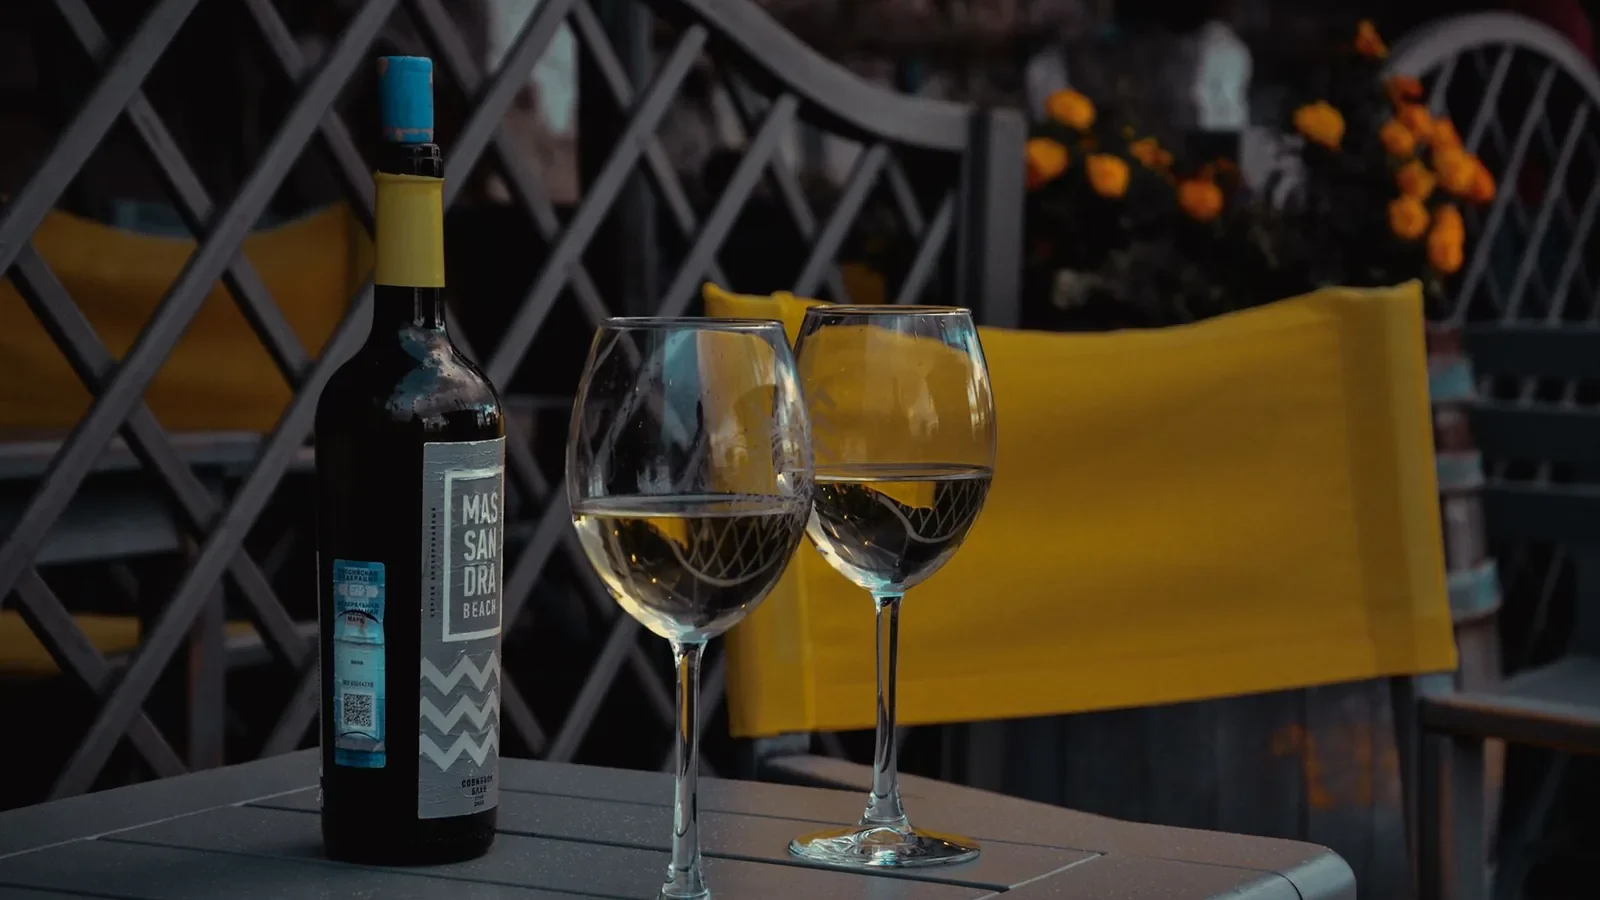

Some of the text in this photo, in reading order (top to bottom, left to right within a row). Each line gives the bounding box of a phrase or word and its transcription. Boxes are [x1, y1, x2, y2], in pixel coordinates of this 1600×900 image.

[462, 491, 498, 525] MAS
[463, 527, 497, 561] SAN
[463, 563, 497, 597] DRA
[463, 599, 497, 619] BEACH
